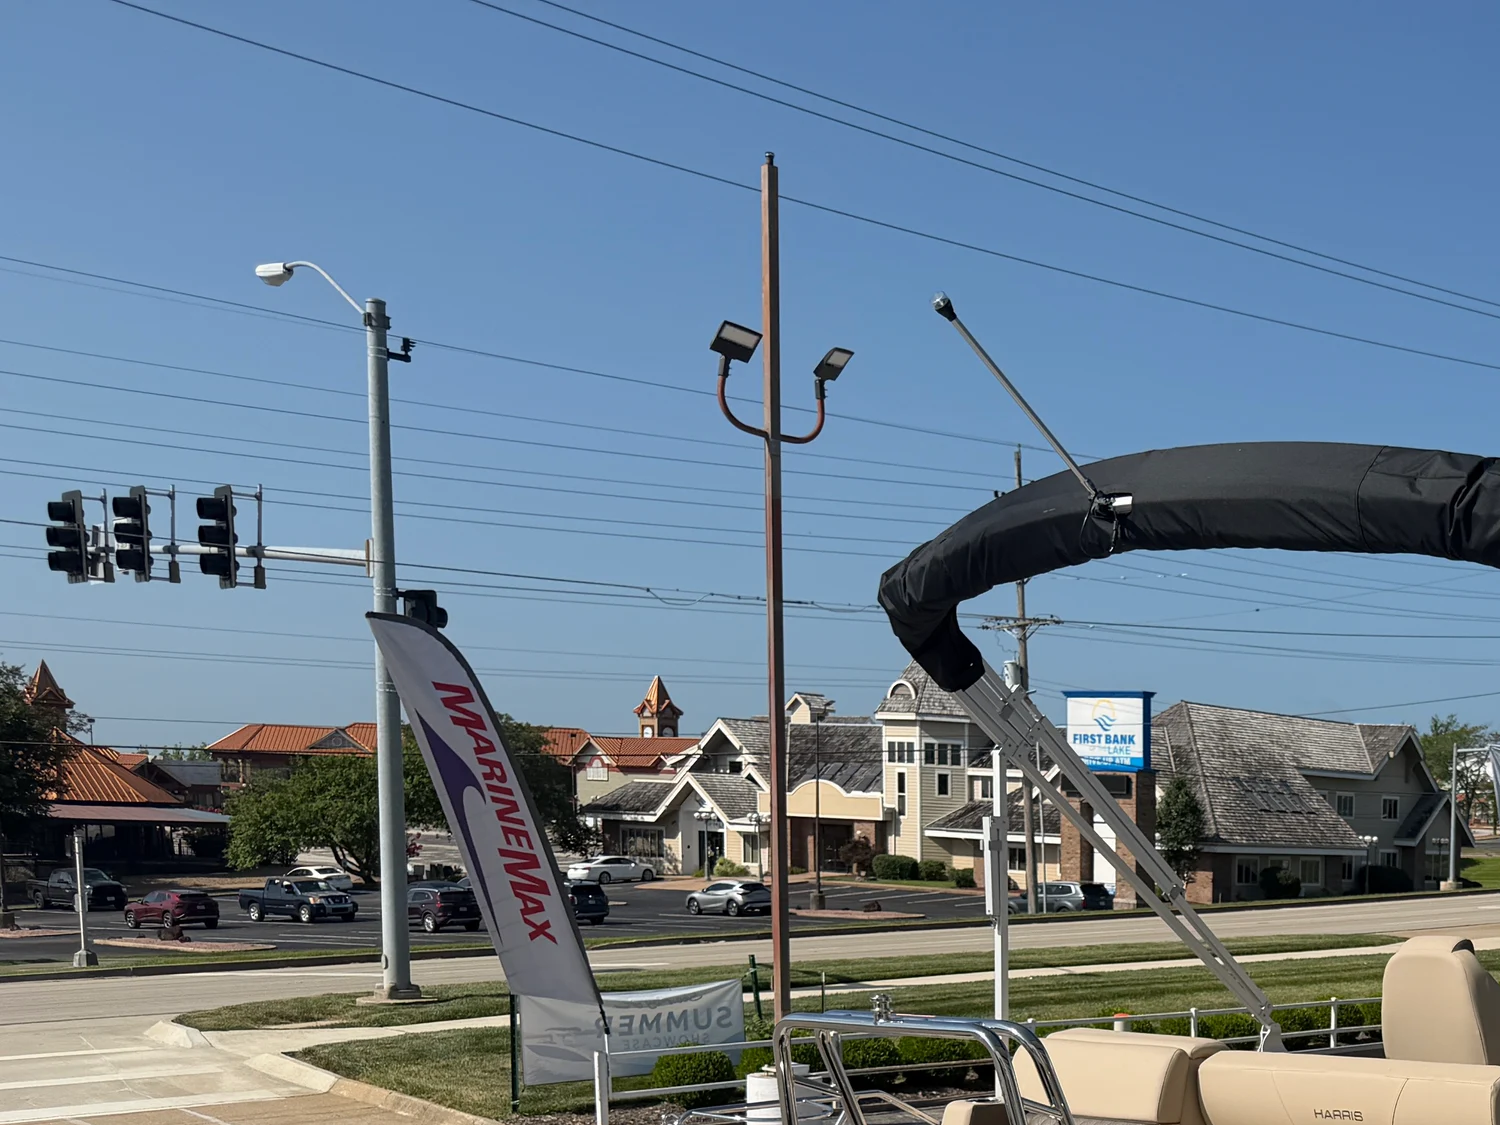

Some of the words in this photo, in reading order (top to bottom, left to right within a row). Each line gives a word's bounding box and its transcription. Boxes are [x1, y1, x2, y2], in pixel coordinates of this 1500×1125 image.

[1072, 734, 1102, 744] FIRST
[1105, 734, 1136, 745] BANK
[1107, 746, 1131, 755] LAKE
[1313, 1109, 1364, 1122] HARRIS
